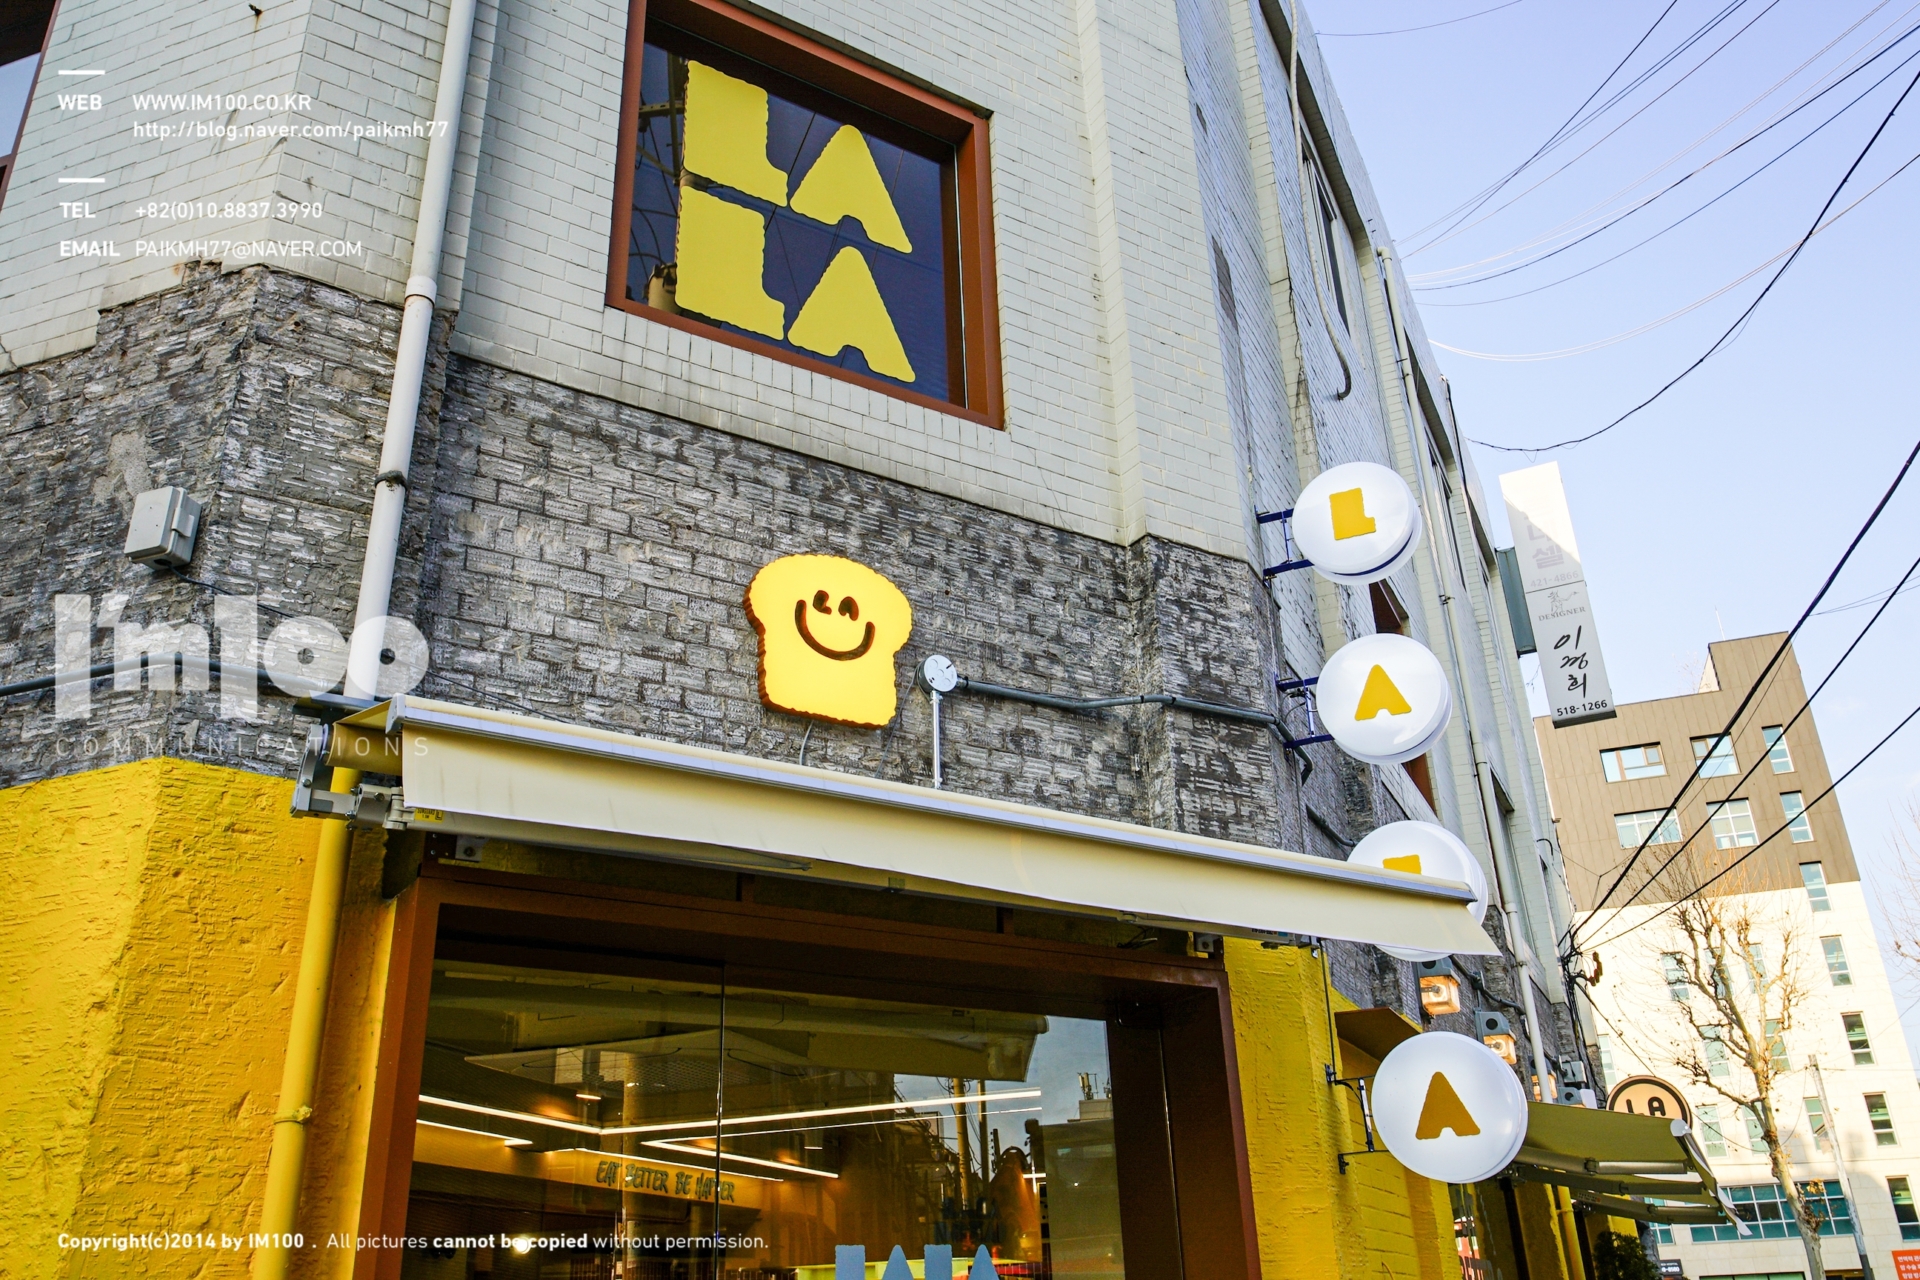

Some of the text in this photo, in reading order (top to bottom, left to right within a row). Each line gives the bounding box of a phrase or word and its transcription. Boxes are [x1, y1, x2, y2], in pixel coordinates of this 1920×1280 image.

[683, 59, 913, 254] LA
[674, 185, 916, 383] LA
[1329, 487, 1377, 541] L
[1530, 571, 1579, 588] 421-4866
[1538, 606, 1586, 622] DESIGNER
[1354, 664, 1412, 721] A
[1556, 699, 1608, 717] 518-1266
[1415, 1071, 1481, 1140] A
[596, 1160, 622, 1187] EAT
[675, 1171, 693, 1195] BE
